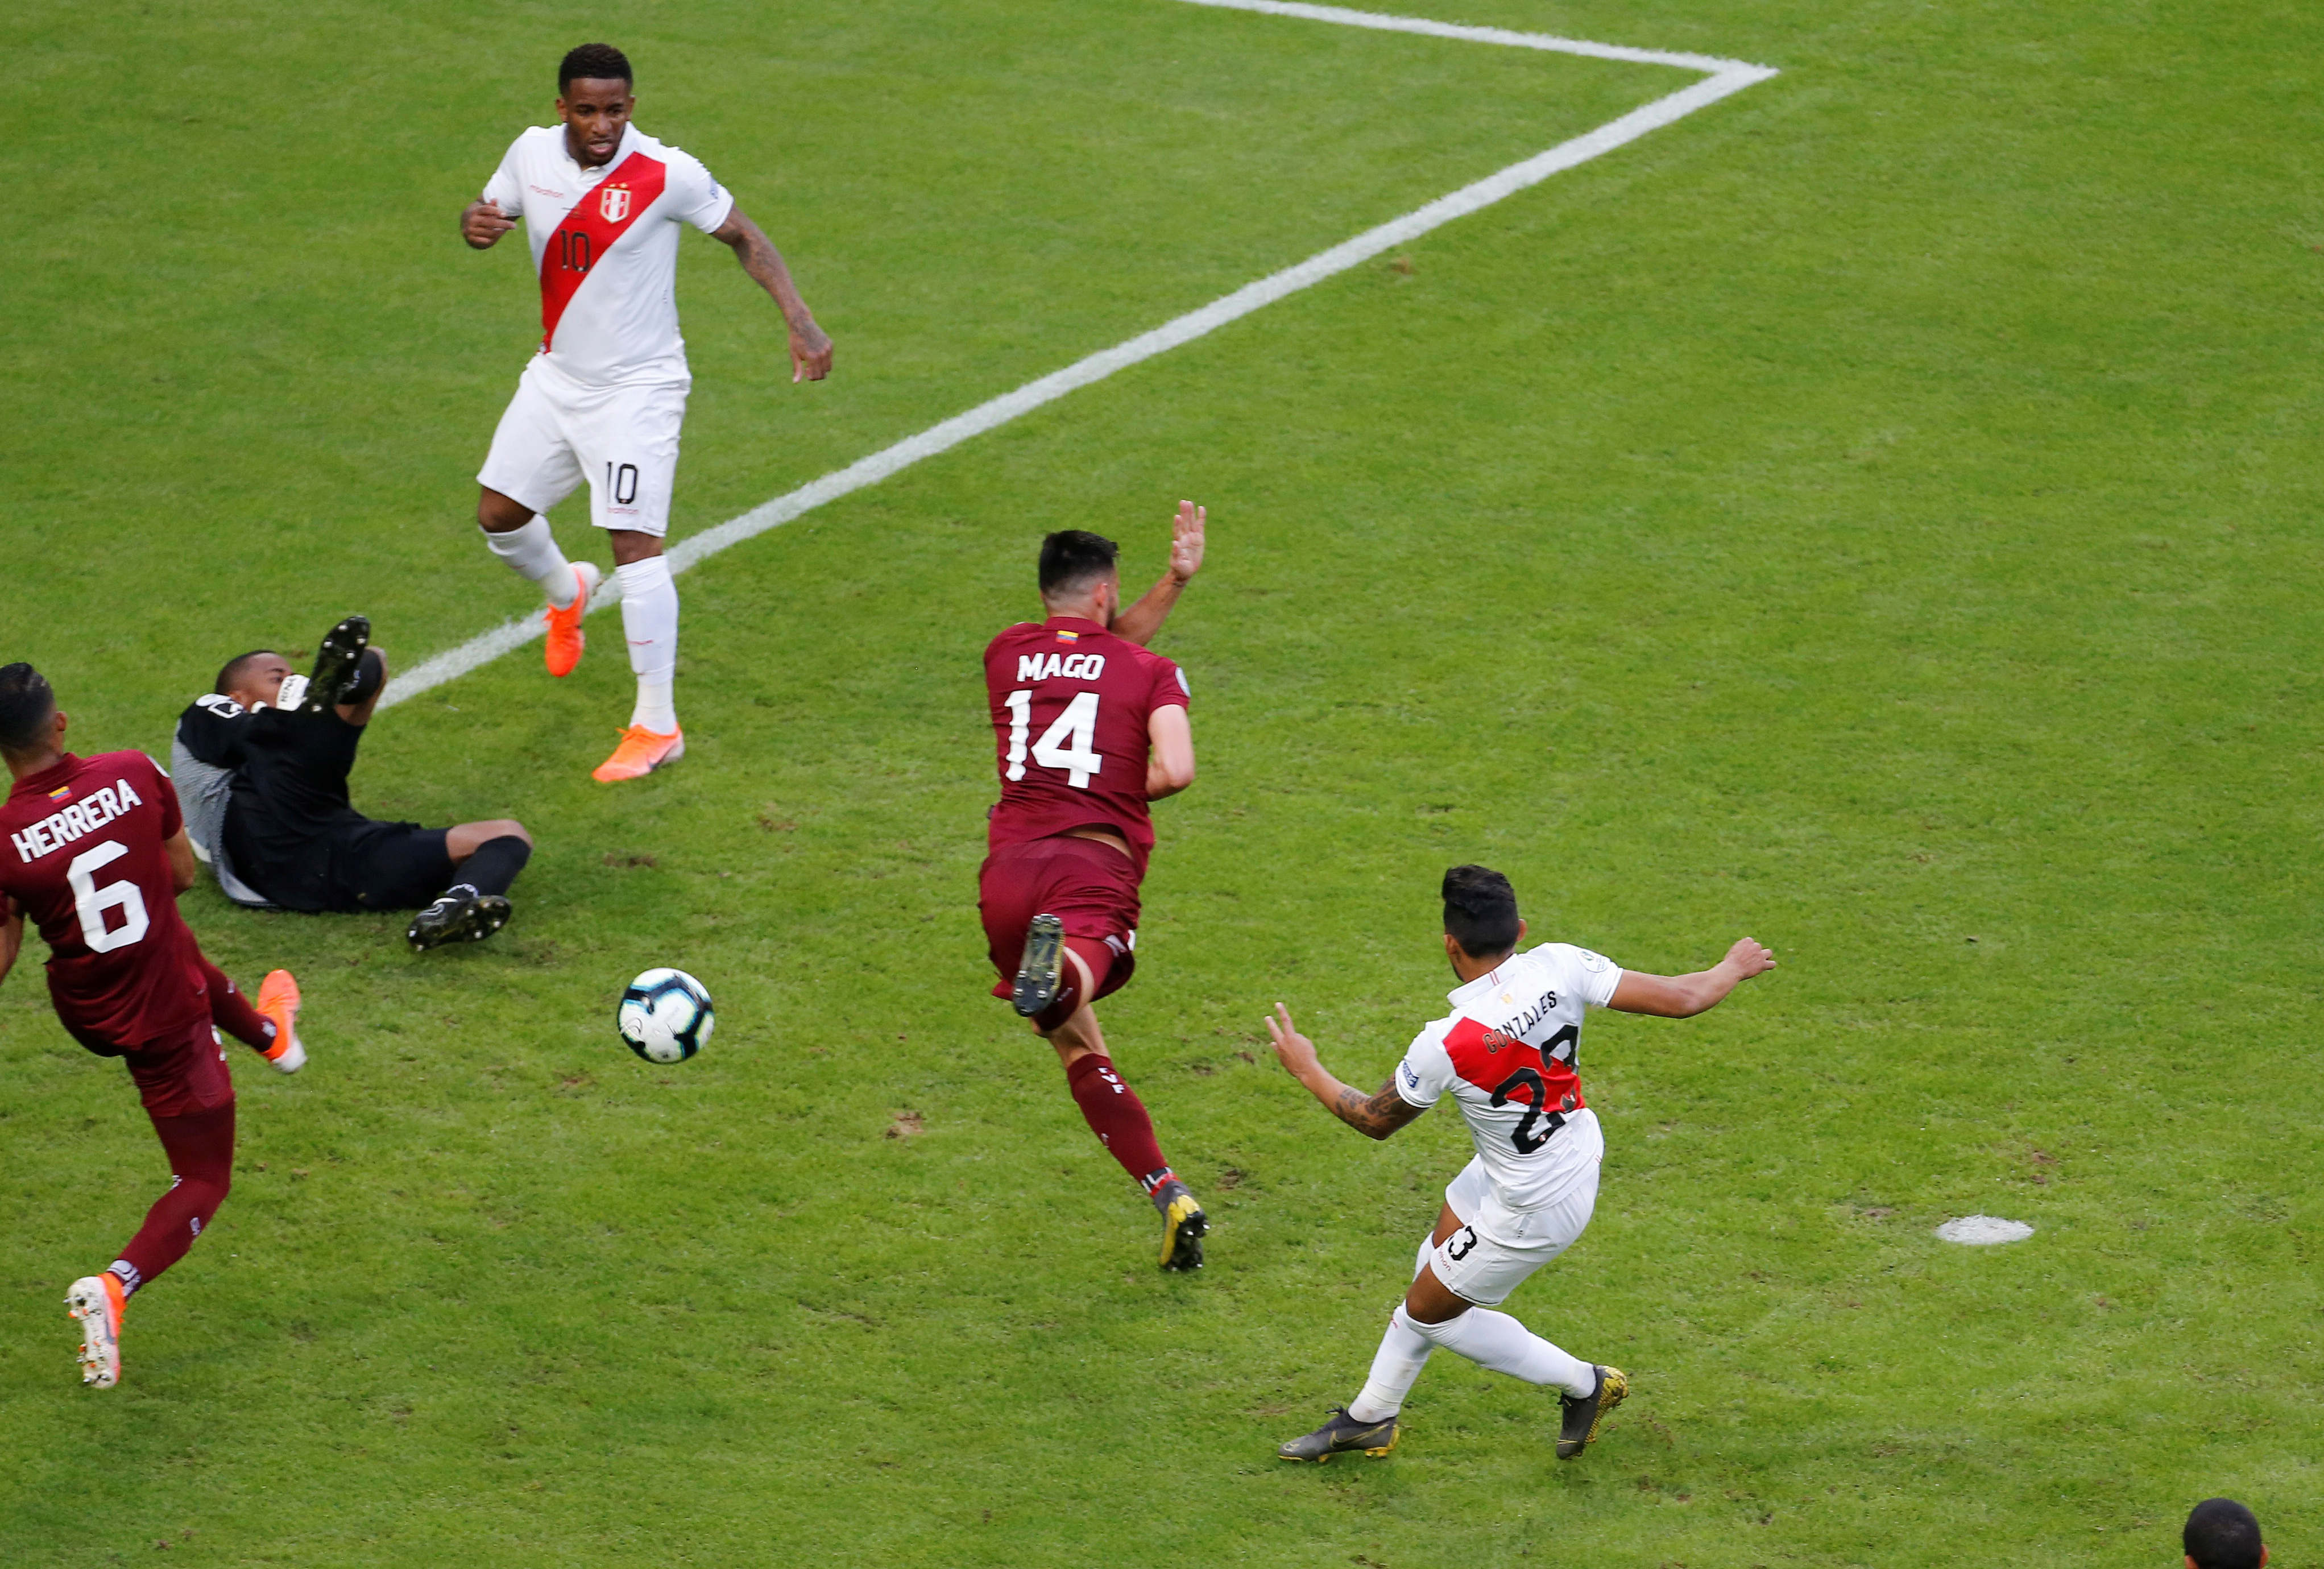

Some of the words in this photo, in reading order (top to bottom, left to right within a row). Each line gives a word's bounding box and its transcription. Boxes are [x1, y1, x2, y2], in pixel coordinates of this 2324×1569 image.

[560, 229, 590, 272] 10
[606, 461, 638, 504] 10
[1017, 653, 1106, 682] MAGO
[1004, 690, 1103, 789] 14
[10, 779, 143, 863] HERRERA
[67, 840, 150, 953] 6
[1483, 991, 1557, 1054] GONZALES
[1448, 1225, 1477, 1261] 3
